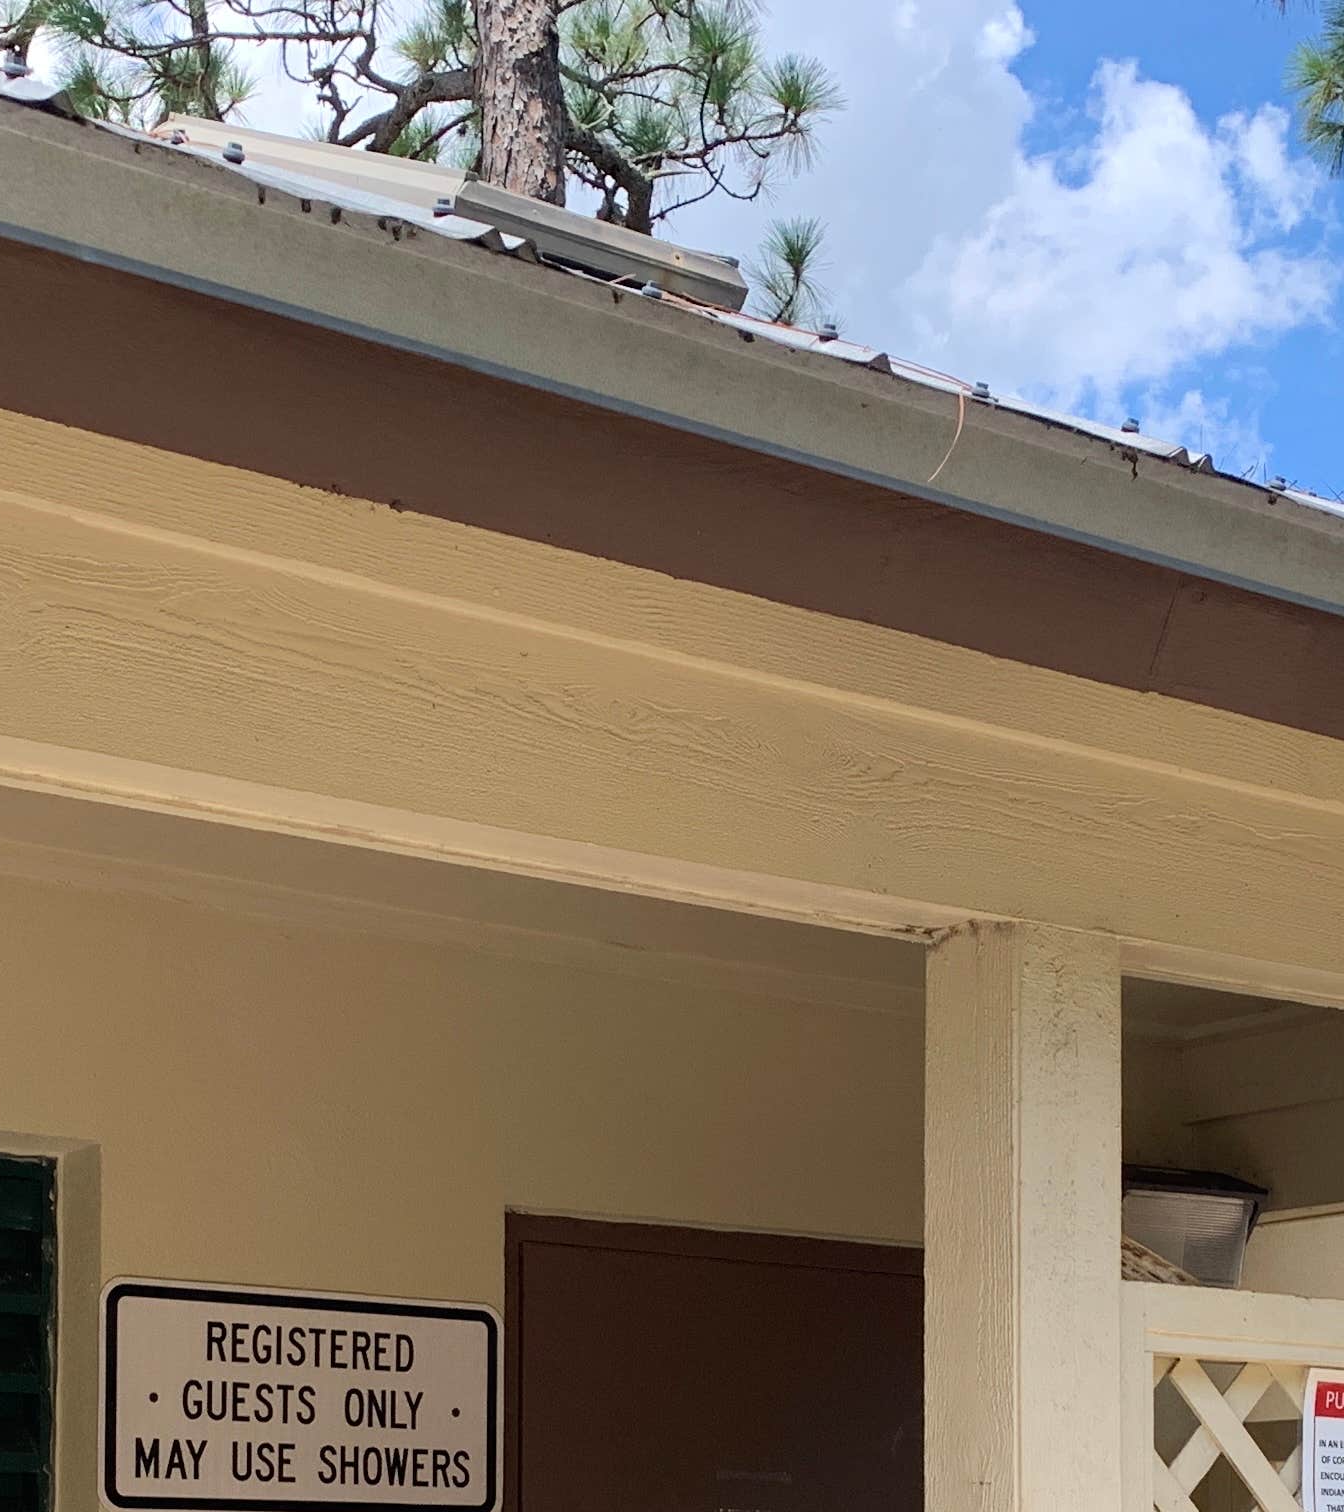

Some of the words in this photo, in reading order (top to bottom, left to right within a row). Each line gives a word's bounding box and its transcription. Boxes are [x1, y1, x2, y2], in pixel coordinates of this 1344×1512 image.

[206, 1320, 414, 1373] REGISTERED
[182, 1379, 316, 1425] GUESTS
[344, 1388, 424, 1430] ONLY
[1319, 1439, 1327, 1448] IN
[1328, 1440, 1338, 1449] AN
[134, 1437, 207, 1480] MAY
[232, 1440, 296, 1483] USE
[317, 1445, 470, 1488] SHOWERS
[1321, 1455, 1331, 1465] OF
[1327, 1504, 1344, 1512] THAT
